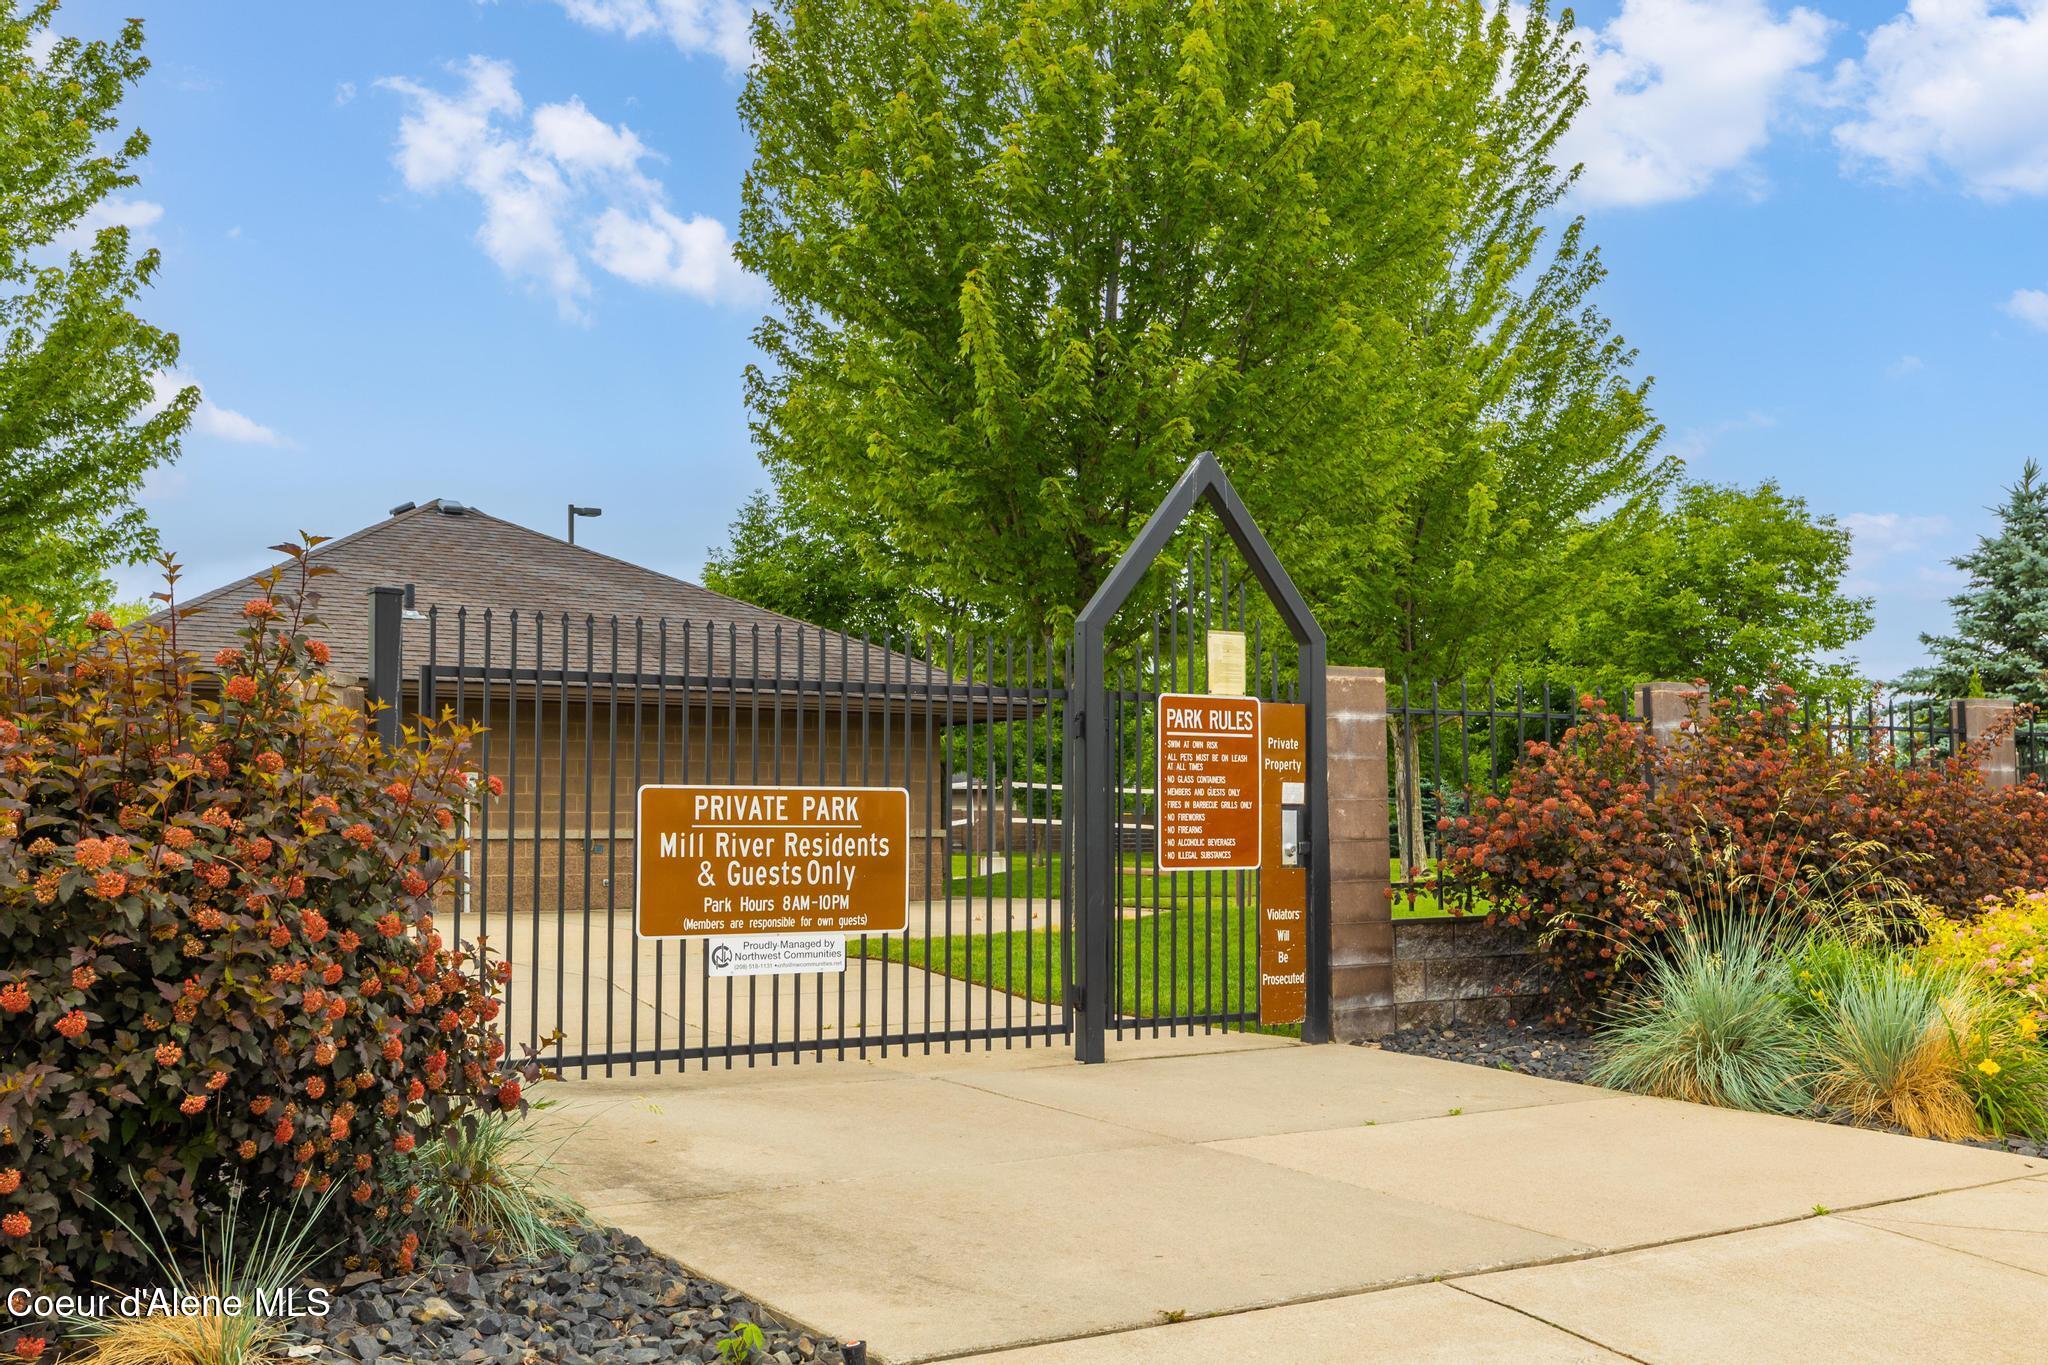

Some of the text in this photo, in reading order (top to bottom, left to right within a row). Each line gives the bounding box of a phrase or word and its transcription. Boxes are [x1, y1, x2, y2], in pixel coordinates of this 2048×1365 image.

[1166, 708, 1253, 730] PARK RULES
[1167, 740, 1181, 748] SWIM
[1207, 741, 1218, 749] RISK
[1268, 737, 1299, 750] Private
[1222, 754, 1229, 762] ON
[1189, 763, 1203, 771] TIMES
[1265, 758, 1301, 773] Property
[694, 795, 859, 821] PRIVATE PARK
[1167, 801, 1182, 809] FIRES
[1185, 801, 1190, 809] IN
[1193, 801, 1218, 809] BARBECUE
[1221, 801, 1238, 809] GRILLS
[660, 832, 889, 858] Mill River Residents
[1178, 851, 1198, 859] ILLEGAL
[1201, 851, 1231, 859] SUBSTANCES
[698, 860, 856, 890] & Guests Only
[704, 895, 849, 912] Park Hours 8AM-10PM
[1267, 909, 1300, 920] Violators
[683, 914, 868, 931] (Members are responsible for own guests)
[1277, 930, 1290, 941] Will
[743, 941, 777, 950] Proudly
[780, 940, 821, 950] Managed
[734, 950, 842, 961] Northwest Communities
[1278, 952, 1289, 963] Be
[1263, 973, 1304, 985] Prosecuted
